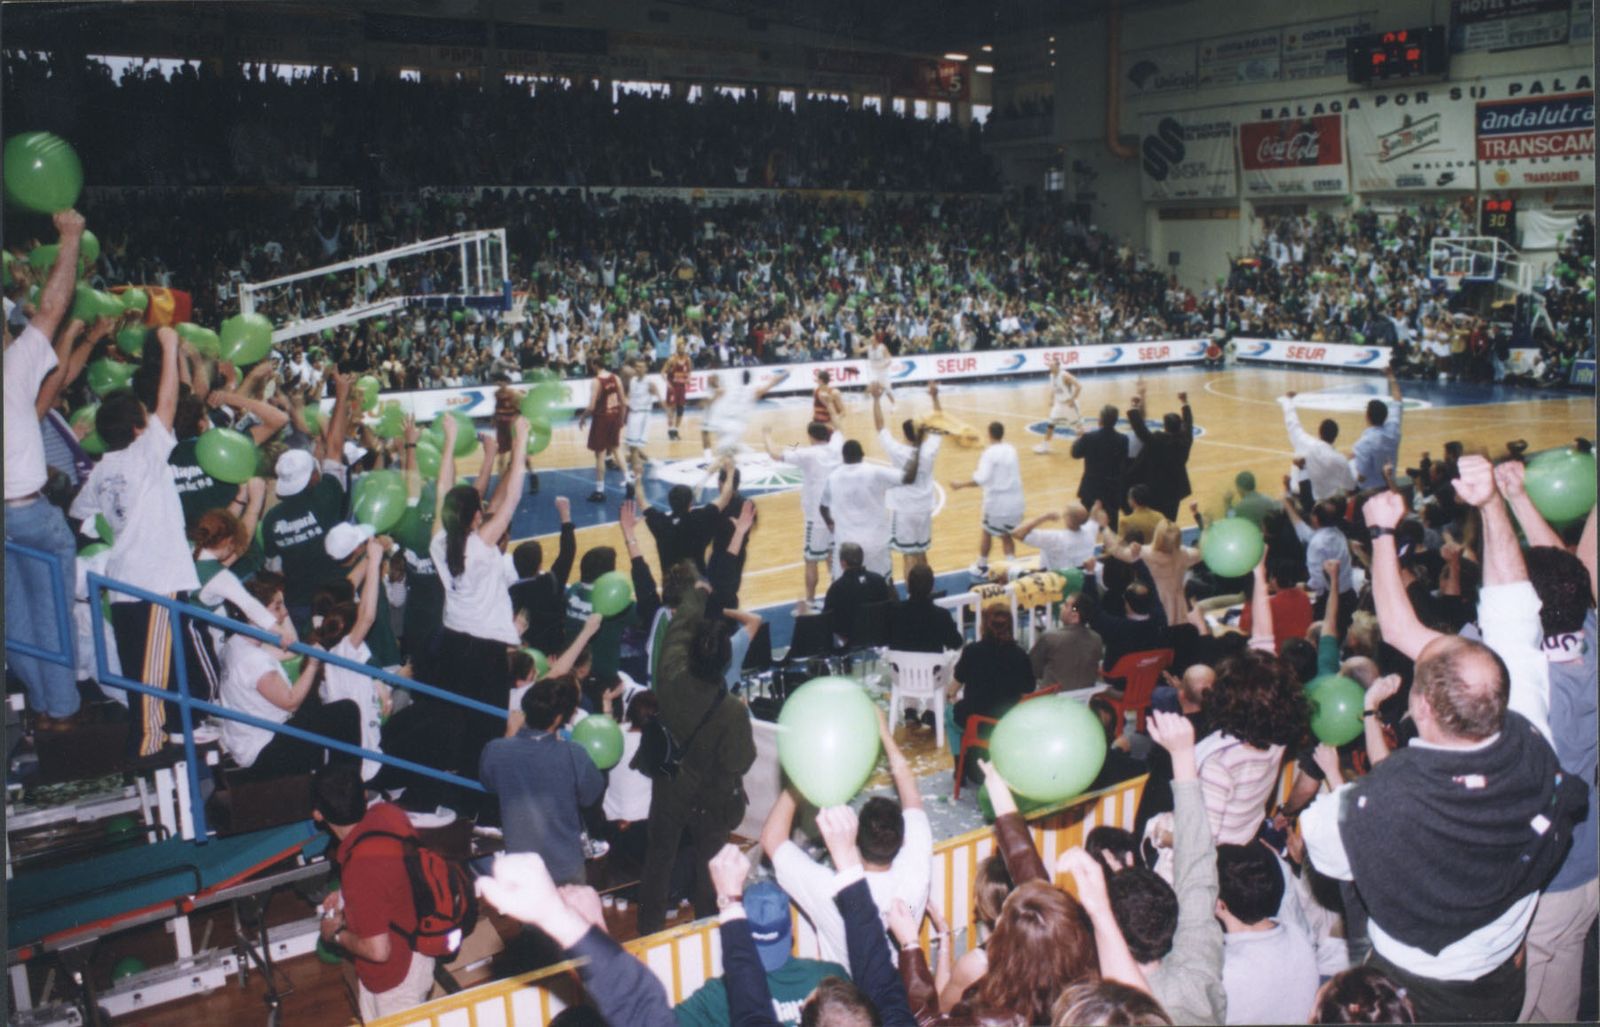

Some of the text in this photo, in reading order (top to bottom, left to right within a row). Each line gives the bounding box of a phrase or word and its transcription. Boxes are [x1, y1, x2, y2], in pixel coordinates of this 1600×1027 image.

[1261, 75, 1592, 120] MALAGA POR SU PALA
[1488, 213, 1507, 227] 30
[1043, 351, 1079, 367] SEUR
[1138, 345, 1170, 361] SEUR
[1286, 345, 1326, 361] SEUR
[937, 358, 976, 374] SEUR
